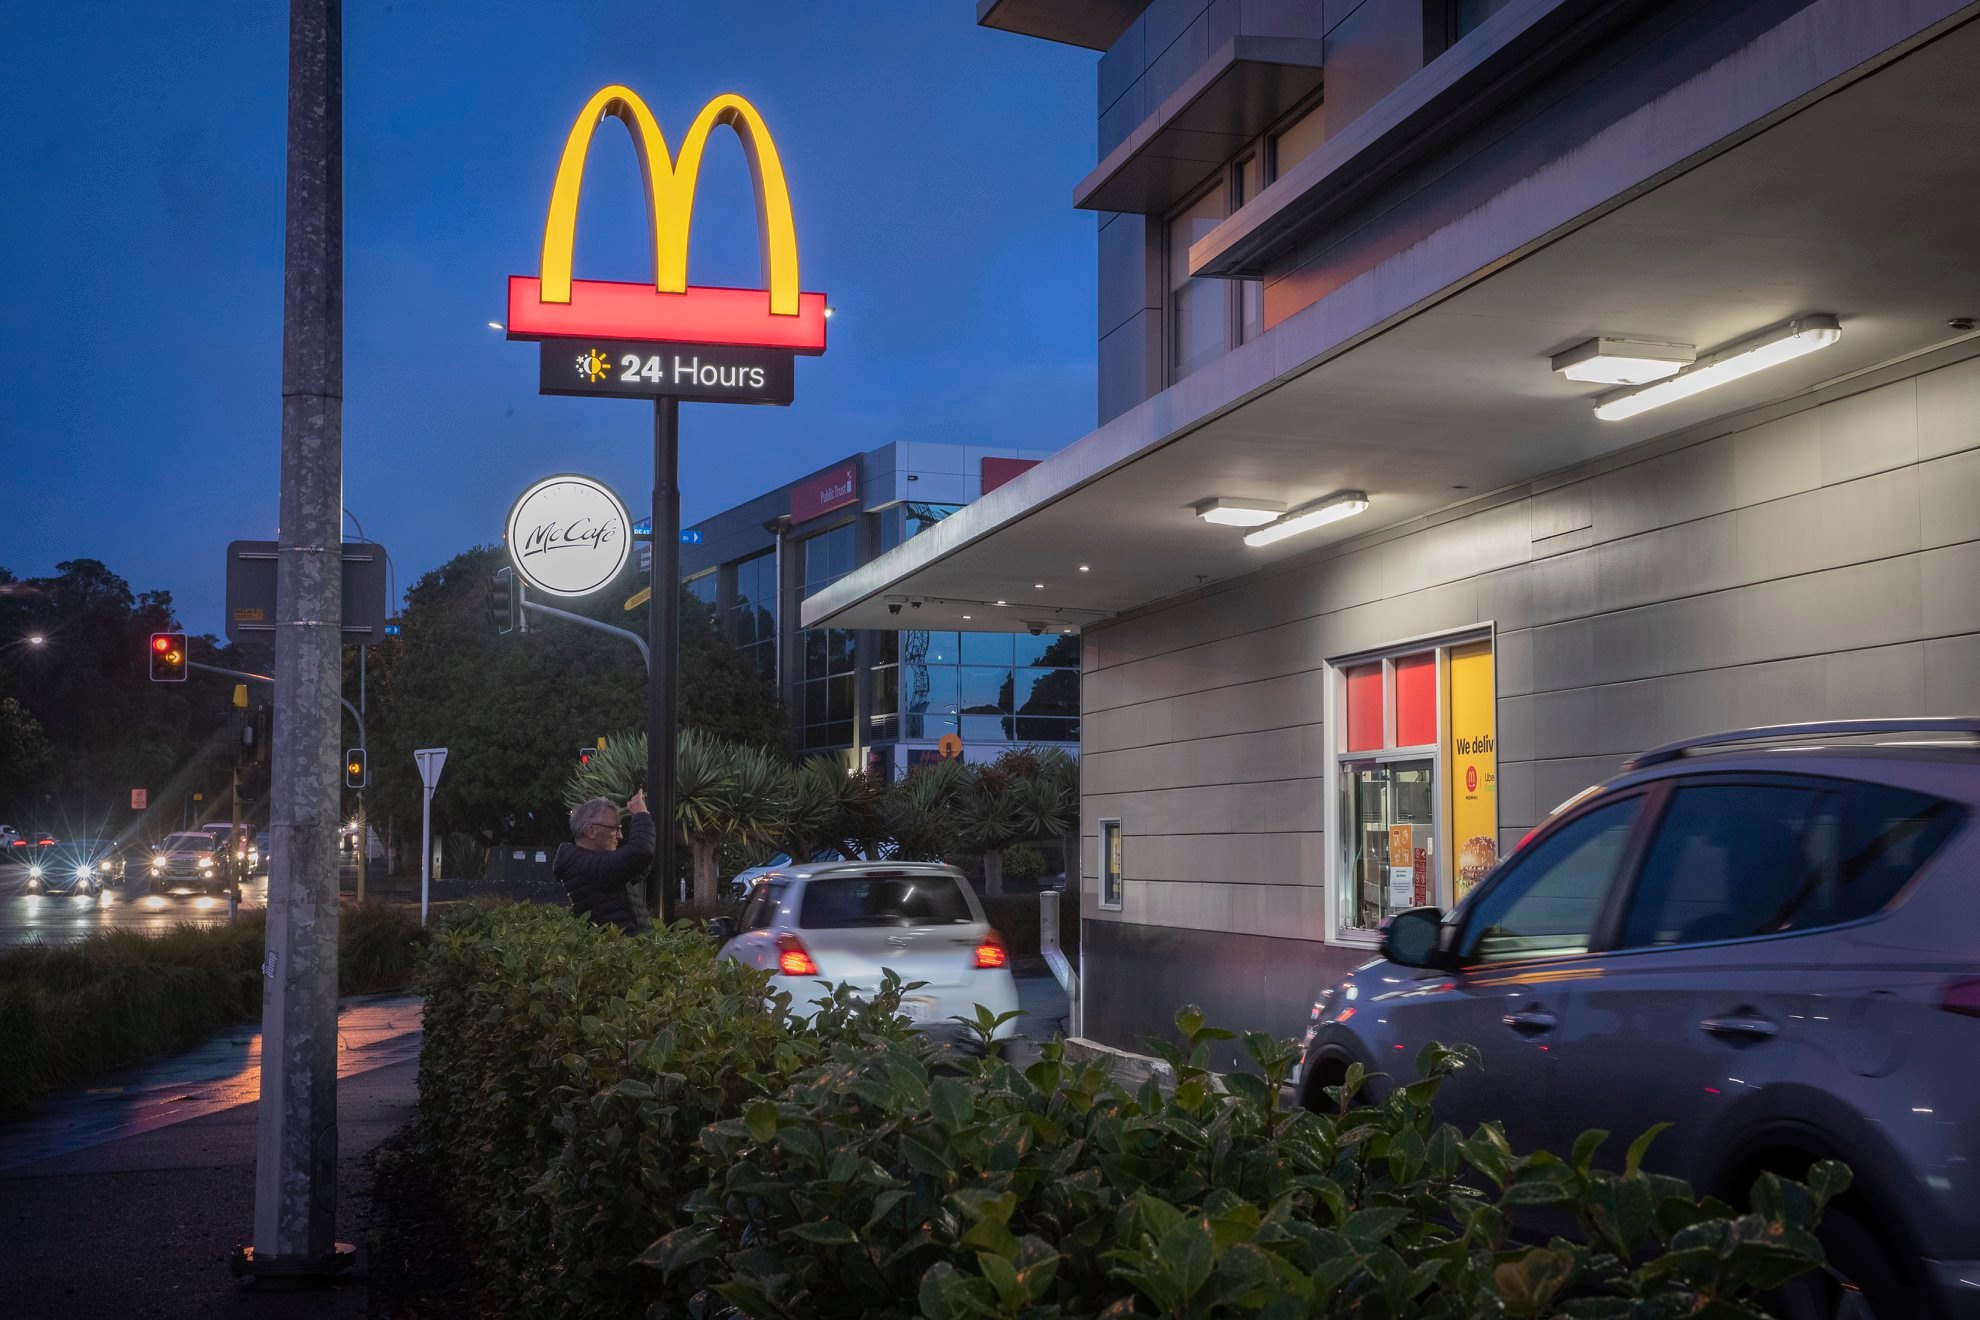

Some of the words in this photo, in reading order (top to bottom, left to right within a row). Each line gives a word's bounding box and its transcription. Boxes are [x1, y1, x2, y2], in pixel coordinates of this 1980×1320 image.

[620, 354, 663, 383] 24
[674, 356, 765, 388] Hours
[820, 487, 834, 504] Public
[834, 482, 847, 498] Trust
[525, 517, 617, 554] McCafé
[1456, 738, 1470, 755] We
[1472, 734, 1494, 754] deliv
